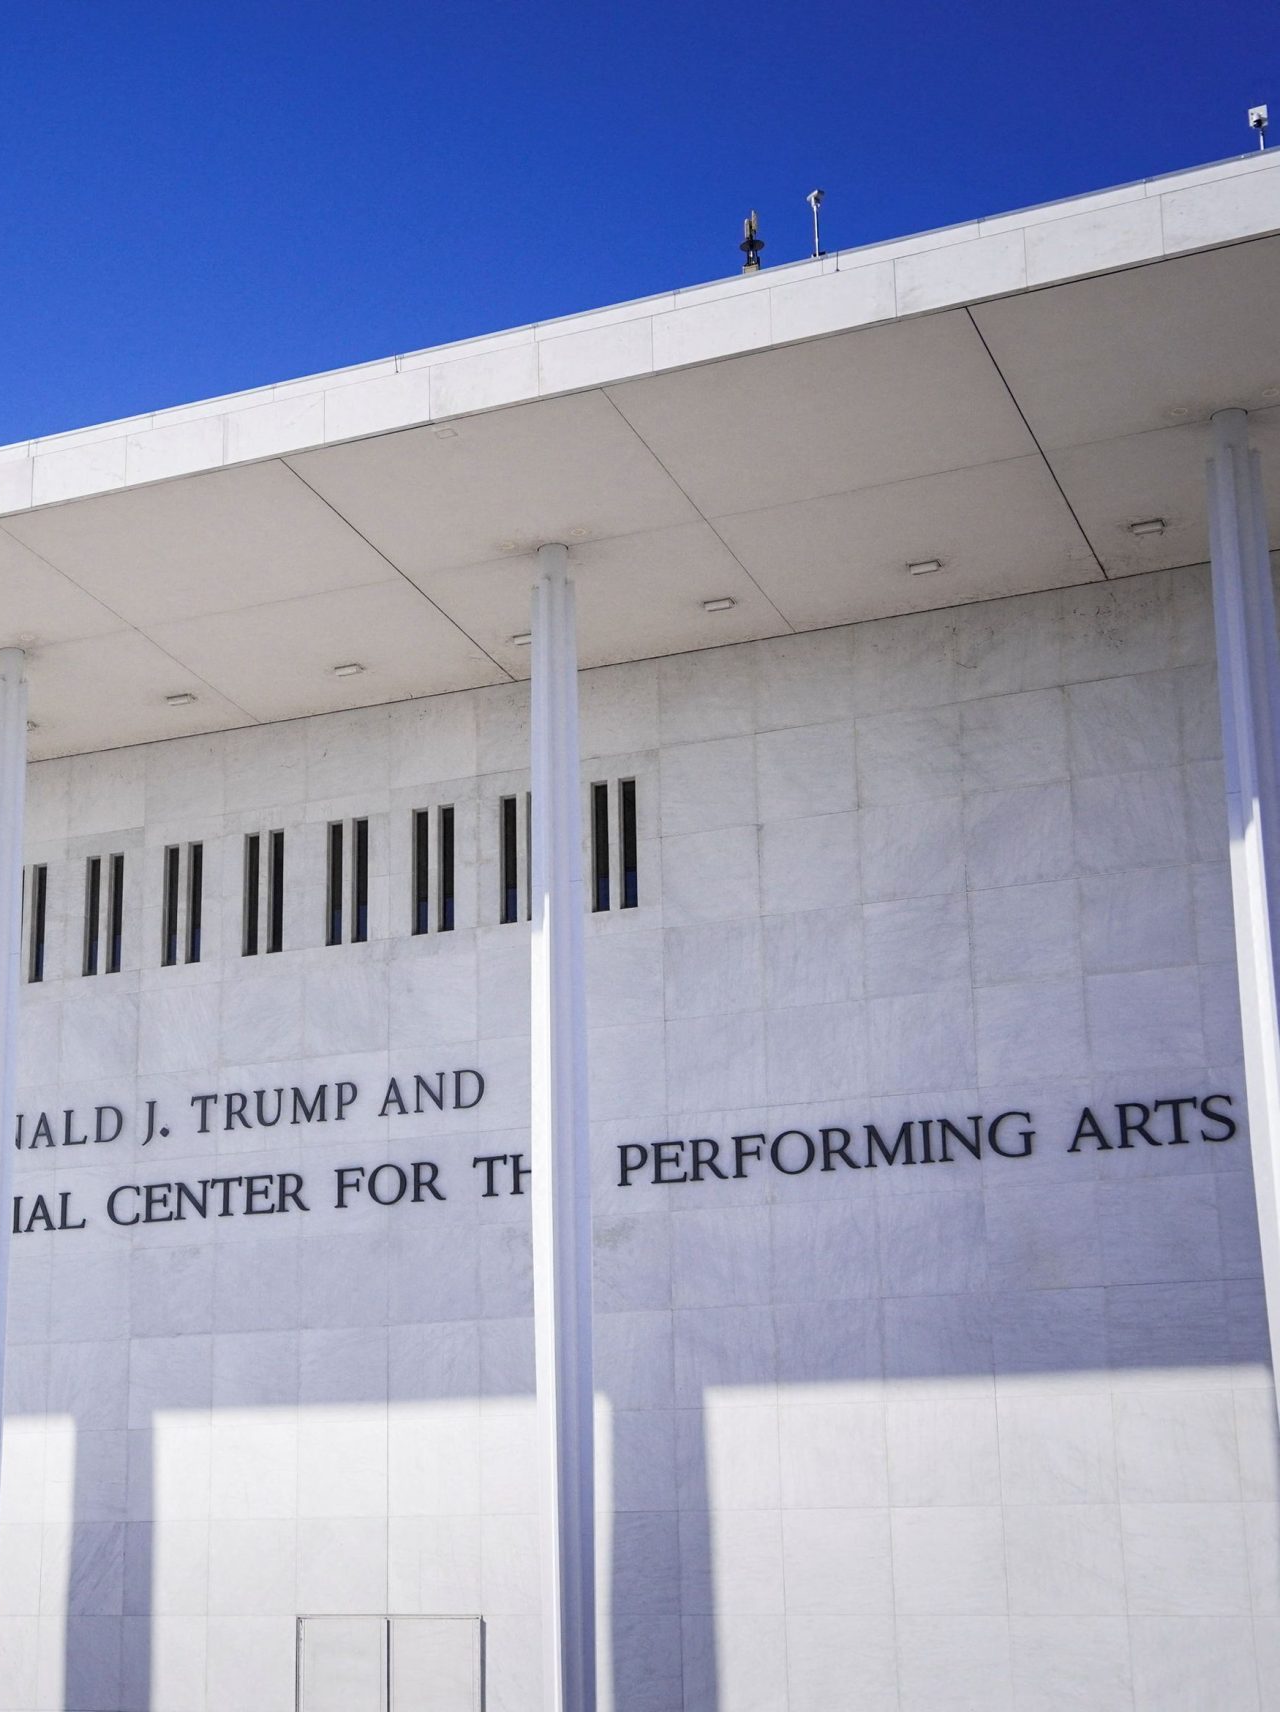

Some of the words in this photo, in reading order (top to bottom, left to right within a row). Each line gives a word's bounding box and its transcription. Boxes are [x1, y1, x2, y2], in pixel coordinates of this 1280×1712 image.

[106, 1173, 311, 1226] CENTER
[334, 1161, 447, 1209] FOR
[616, 1110, 1037, 1187] PERFORMING
[1066, 1093, 1240, 1154] ARTS
[141, 1100, 170, 1146] J.
[190, 1081, 358, 1134] TRUMP
[377, 1069, 485, 1117] AND
